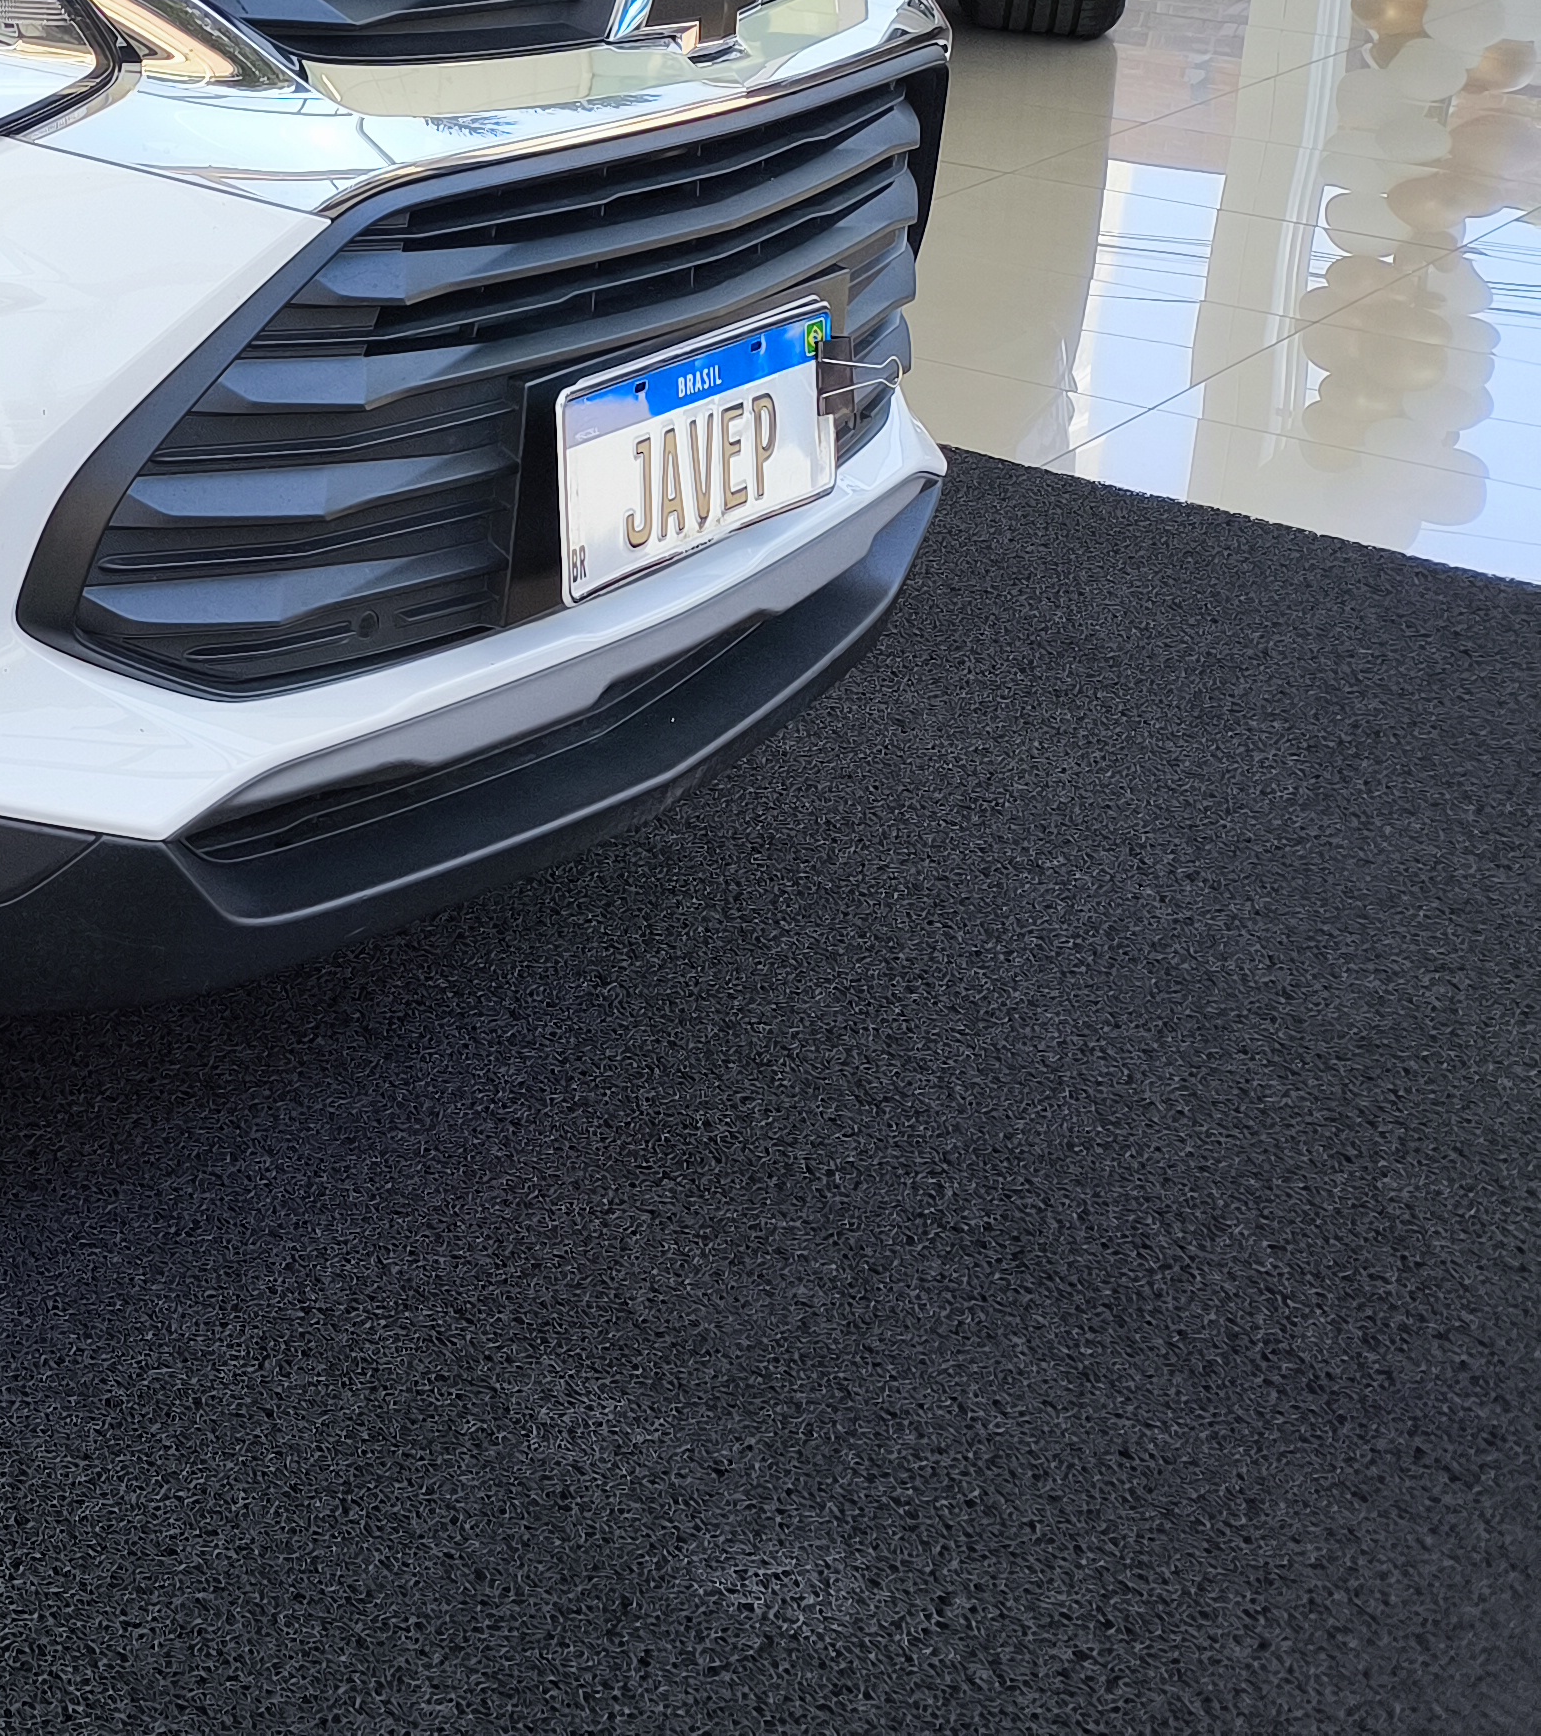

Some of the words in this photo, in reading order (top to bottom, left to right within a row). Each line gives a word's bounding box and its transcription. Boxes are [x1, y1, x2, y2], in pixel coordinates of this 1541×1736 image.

[677, 365, 723, 398] BRASIL
[625, 392, 777, 549] JAVEP
[571, 545, 588, 584] BR
